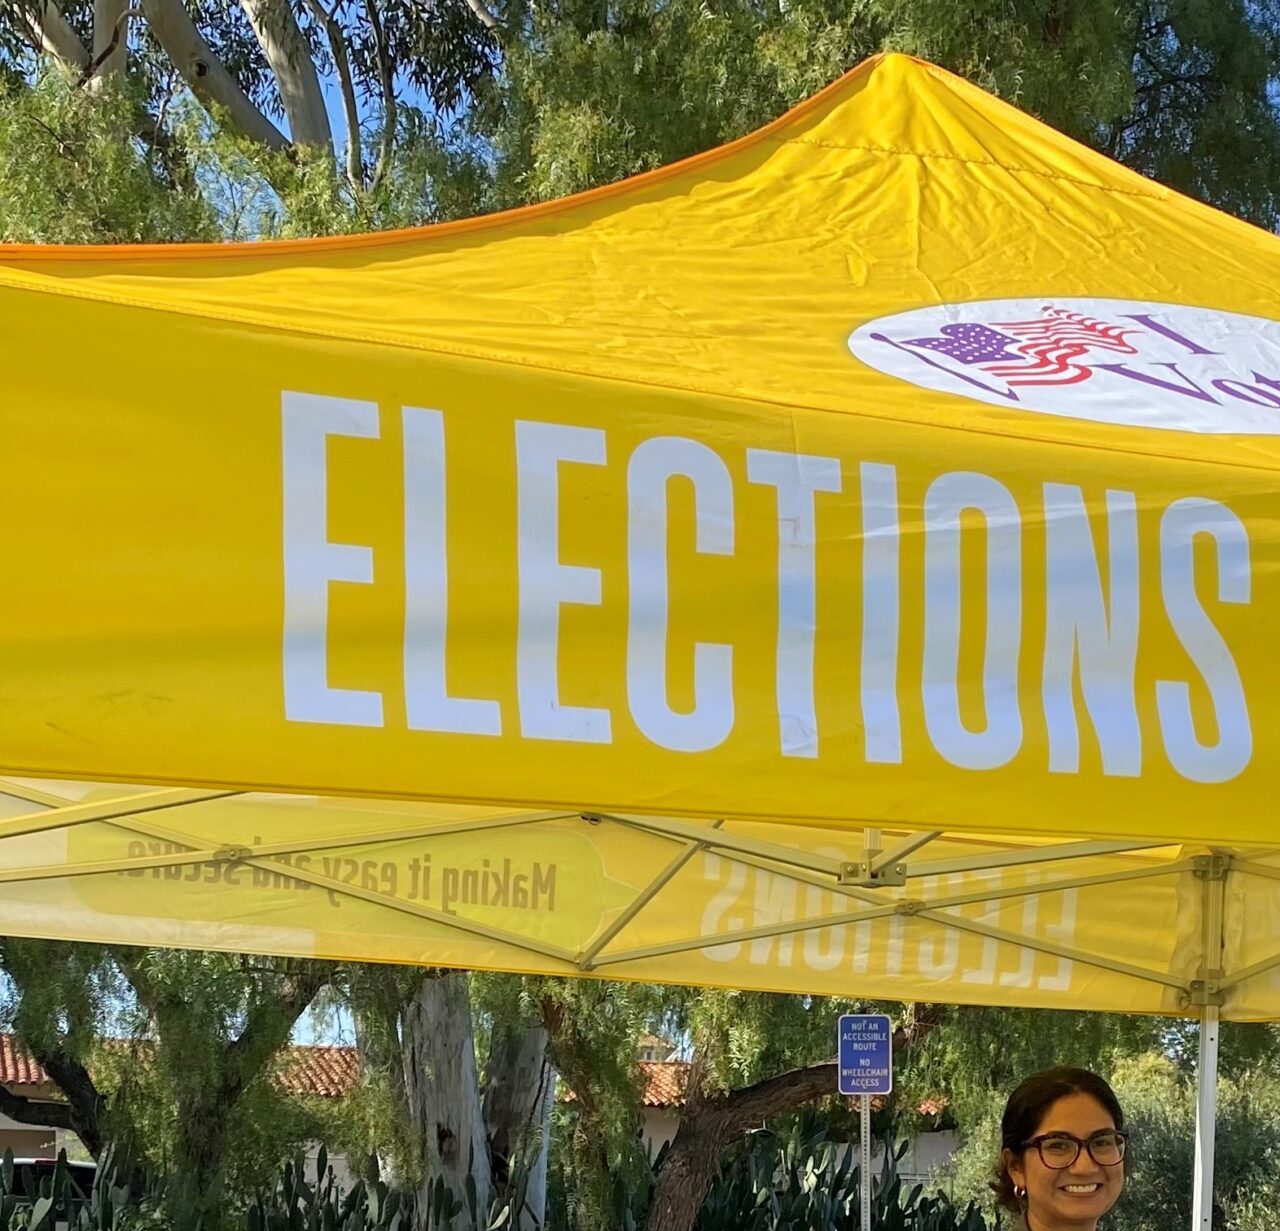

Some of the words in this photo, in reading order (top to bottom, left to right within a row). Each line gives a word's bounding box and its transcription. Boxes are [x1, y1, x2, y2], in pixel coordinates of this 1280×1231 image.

[1118, 313, 1225, 356] I
[281, 390, 1254, 785] ELECTIONS
[851, 1022, 866, 1031] NOT
[868, 1022, 879, 1031] AN
[842, 1032, 887, 1041] ACCESSIBLE
[853, 1042, 877, 1051] ROUTE
[859, 1057, 870, 1067] NO
[842, 1068, 888, 1077] WHEELCHAIR
[850, 1078, 879, 1087] ACCESS
